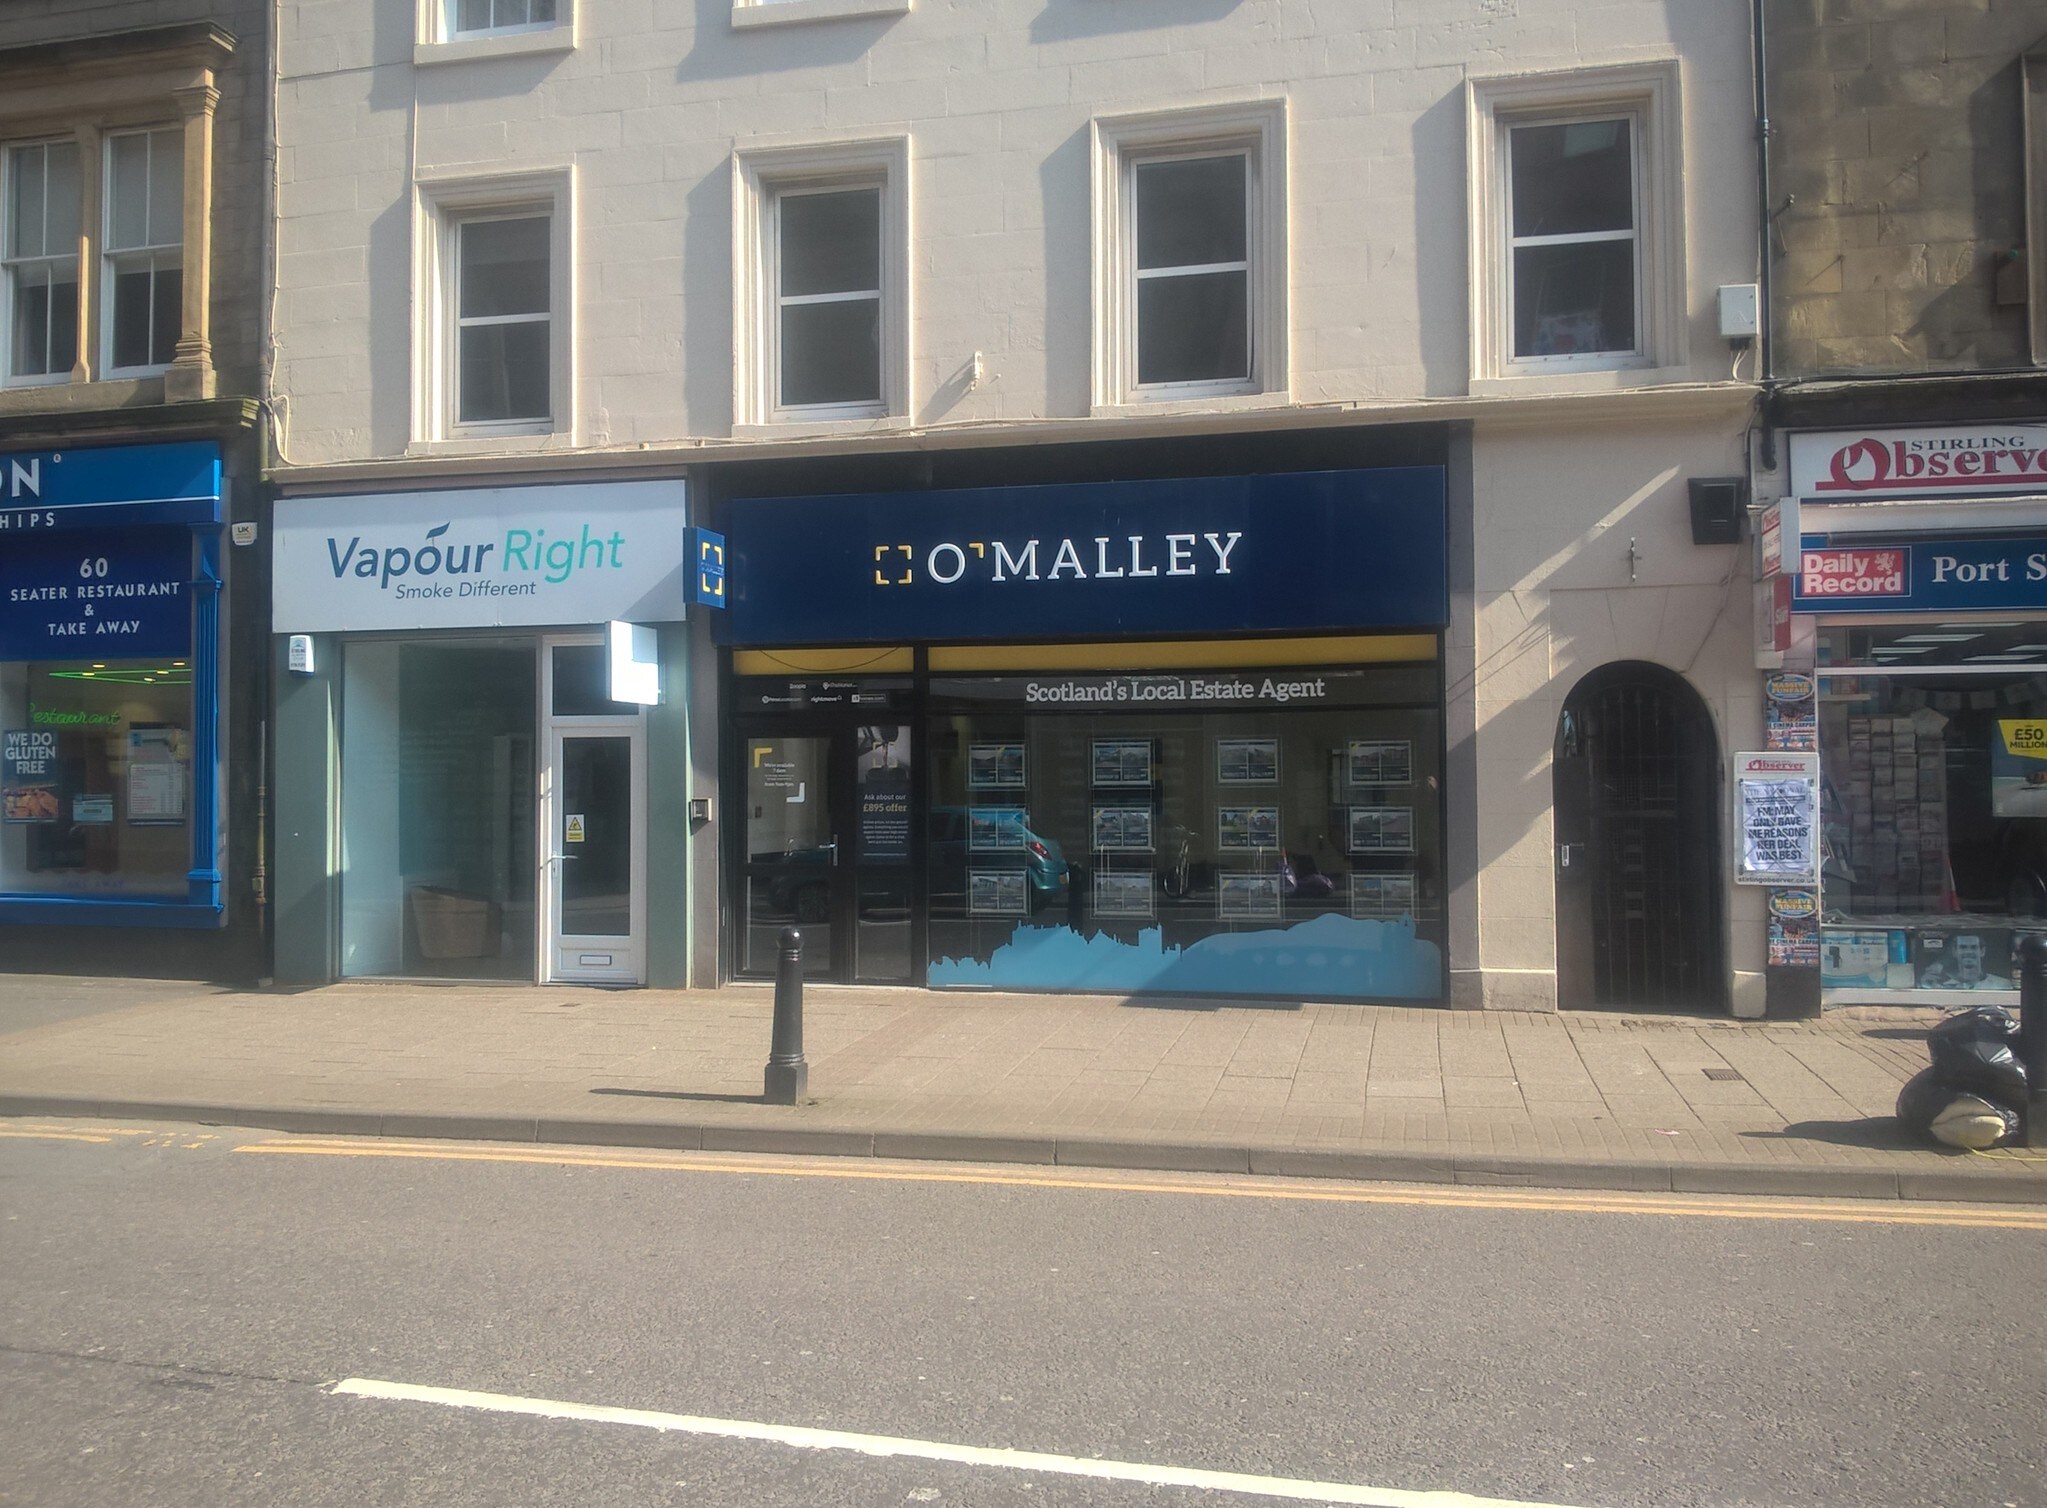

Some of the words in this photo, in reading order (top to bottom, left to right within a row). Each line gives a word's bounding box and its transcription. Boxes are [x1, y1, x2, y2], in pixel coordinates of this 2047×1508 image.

[1911, 436, 2024, 451] STIRLING
[0, 458, 40, 498] N
[327, 535, 494, 589] Vapour
[502, 524, 625, 584] Right
[79, 557, 109, 578] 60
[1803, 553, 1869, 577] Daily
[1932, 556, 2010, 583] Port
[395, 583, 453, 599] Smoke
[458, 580, 537, 598] Different
[1803, 572, 1901, 594] Record
[10, 586, 69, 602] SEATER
[77, 582, 180, 599] RESTAURANT
[84, 603, 95, 617] &
[48, 622, 87, 636] TAKE
[95, 620, 141, 634] AWAY
[1026, 682, 1127, 702] Scotland's
[1130, 680, 1186, 701] Local
[1190, 679, 1254, 699] Estate
[1258, 678, 1325, 702] Agent
[8, 734, 29, 747] WE
[31, 732, 53, 746] DO
[2014, 728, 2044, 741] £50
[2009, 741, 2047, 749] MILLION
[5, 746, 56, 760] GLUTEN
[16, 760, 46, 774] FREE
[1748, 759, 1806, 769] Observer
[863, 803, 884, 812] £895
[885, 803, 907, 812] offer
[1775, 803, 1796, 816] MAY
[1753, 817, 1777, 827] ONLY
[1777, 816, 1802, 826] GAVE
[1764, 827, 1808, 838] REASONS
[1777, 839, 1801, 849] DEAL
[1756, 850, 1778, 861] WAS
[1778, 850, 1803, 860] BEST
